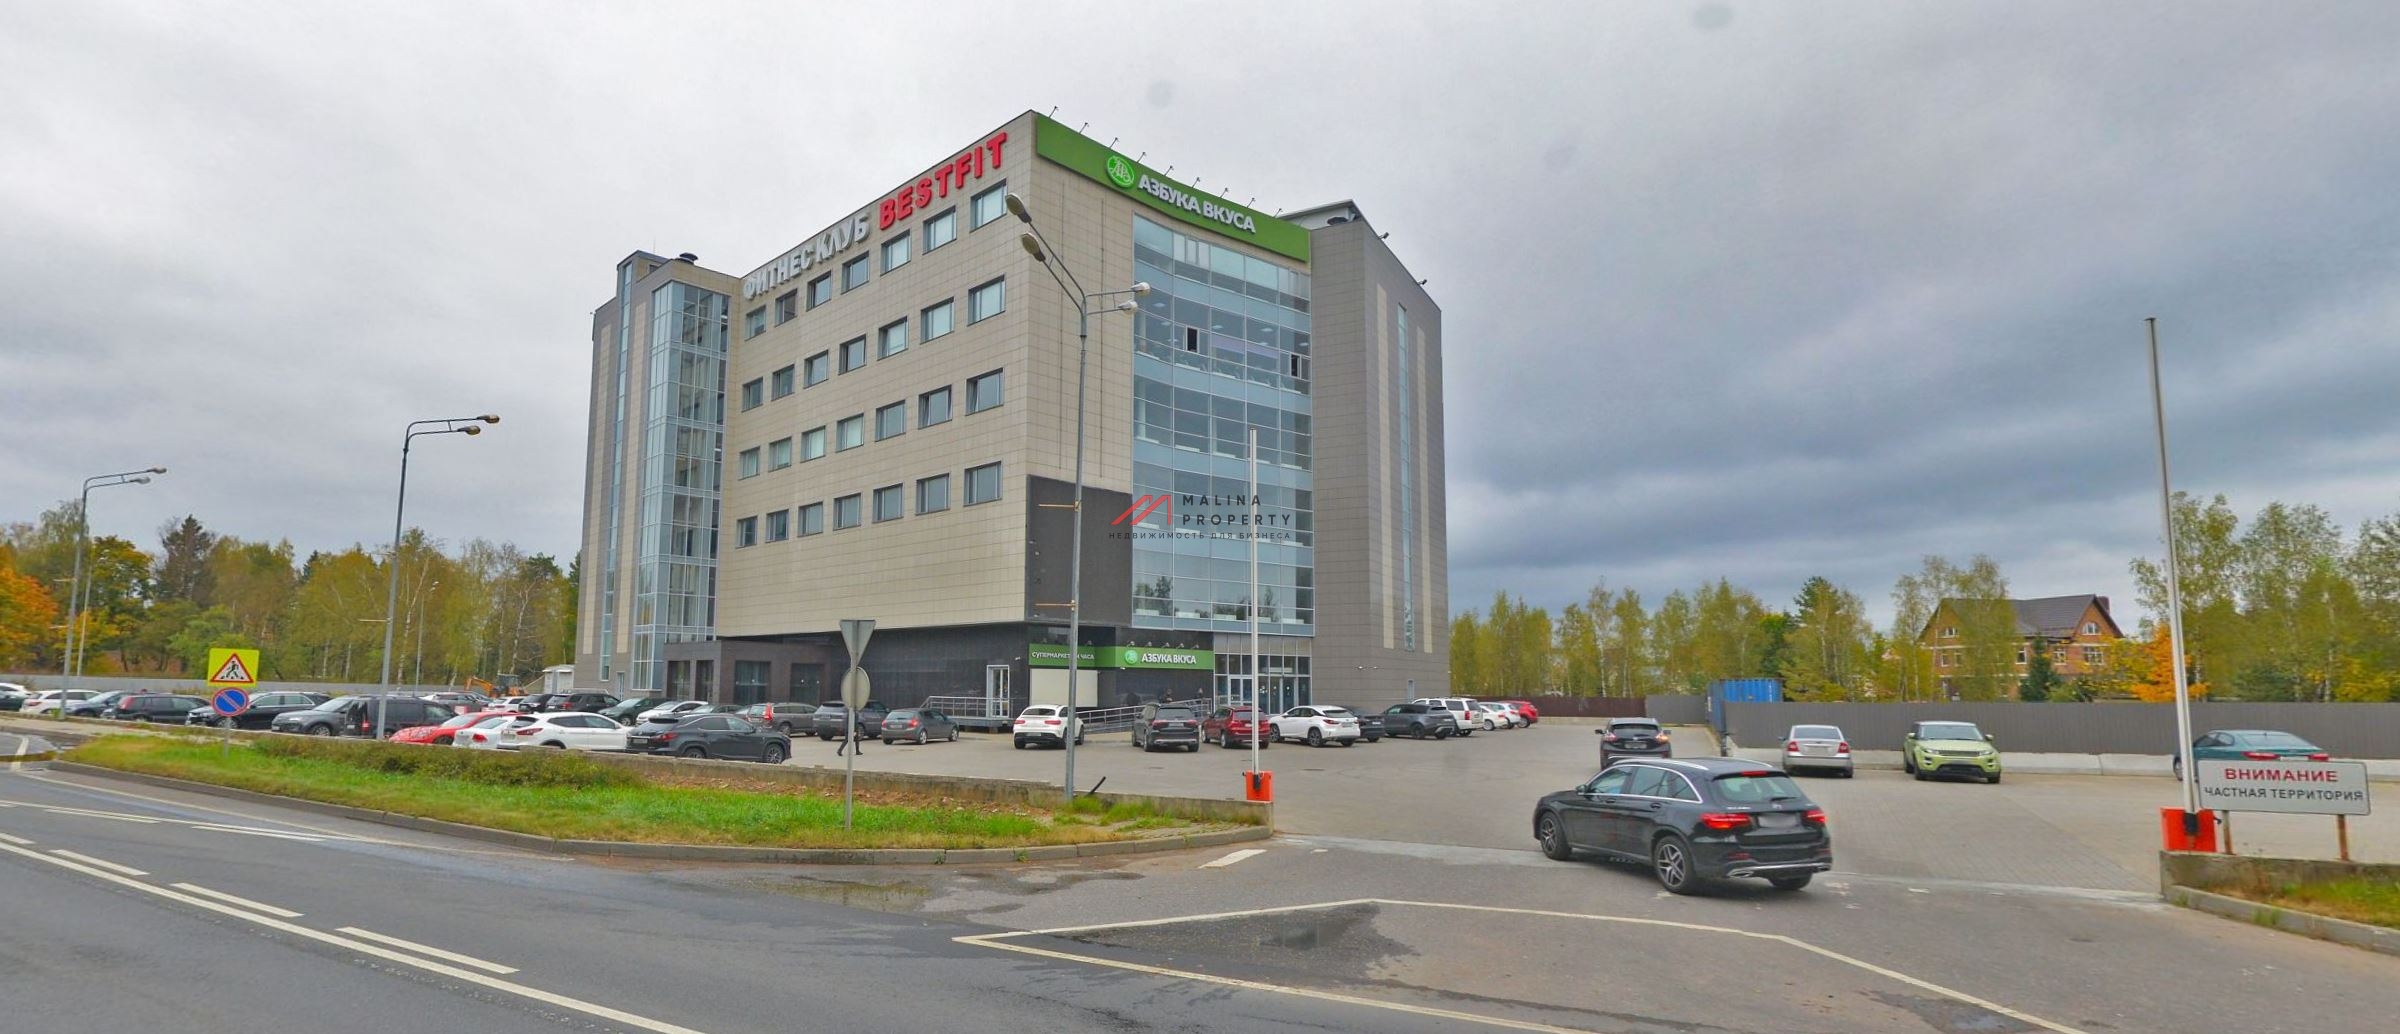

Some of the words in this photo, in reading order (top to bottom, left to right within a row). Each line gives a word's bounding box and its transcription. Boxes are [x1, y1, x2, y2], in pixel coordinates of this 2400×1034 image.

[1138, 174, 1201, 214] АЗБУКА
[1202, 201, 1256, 233] ВКУСА
[743, 244, 816, 301] ФИТНЕС
[815, 212, 871, 265] КЛУБ
[879, 131, 1007, 231] BESTFIT
[1141, 653, 1172, 664] АЗБУКА
[1173, 654, 1197, 665] ВКУСА
[2224, 768, 2338, 783] ВНИМАНИЕ
[2204, 786, 2267, 799] ЧАСТНАЯ
[2272, 788, 2364, 801] ТЕРРИТОРИЯ
